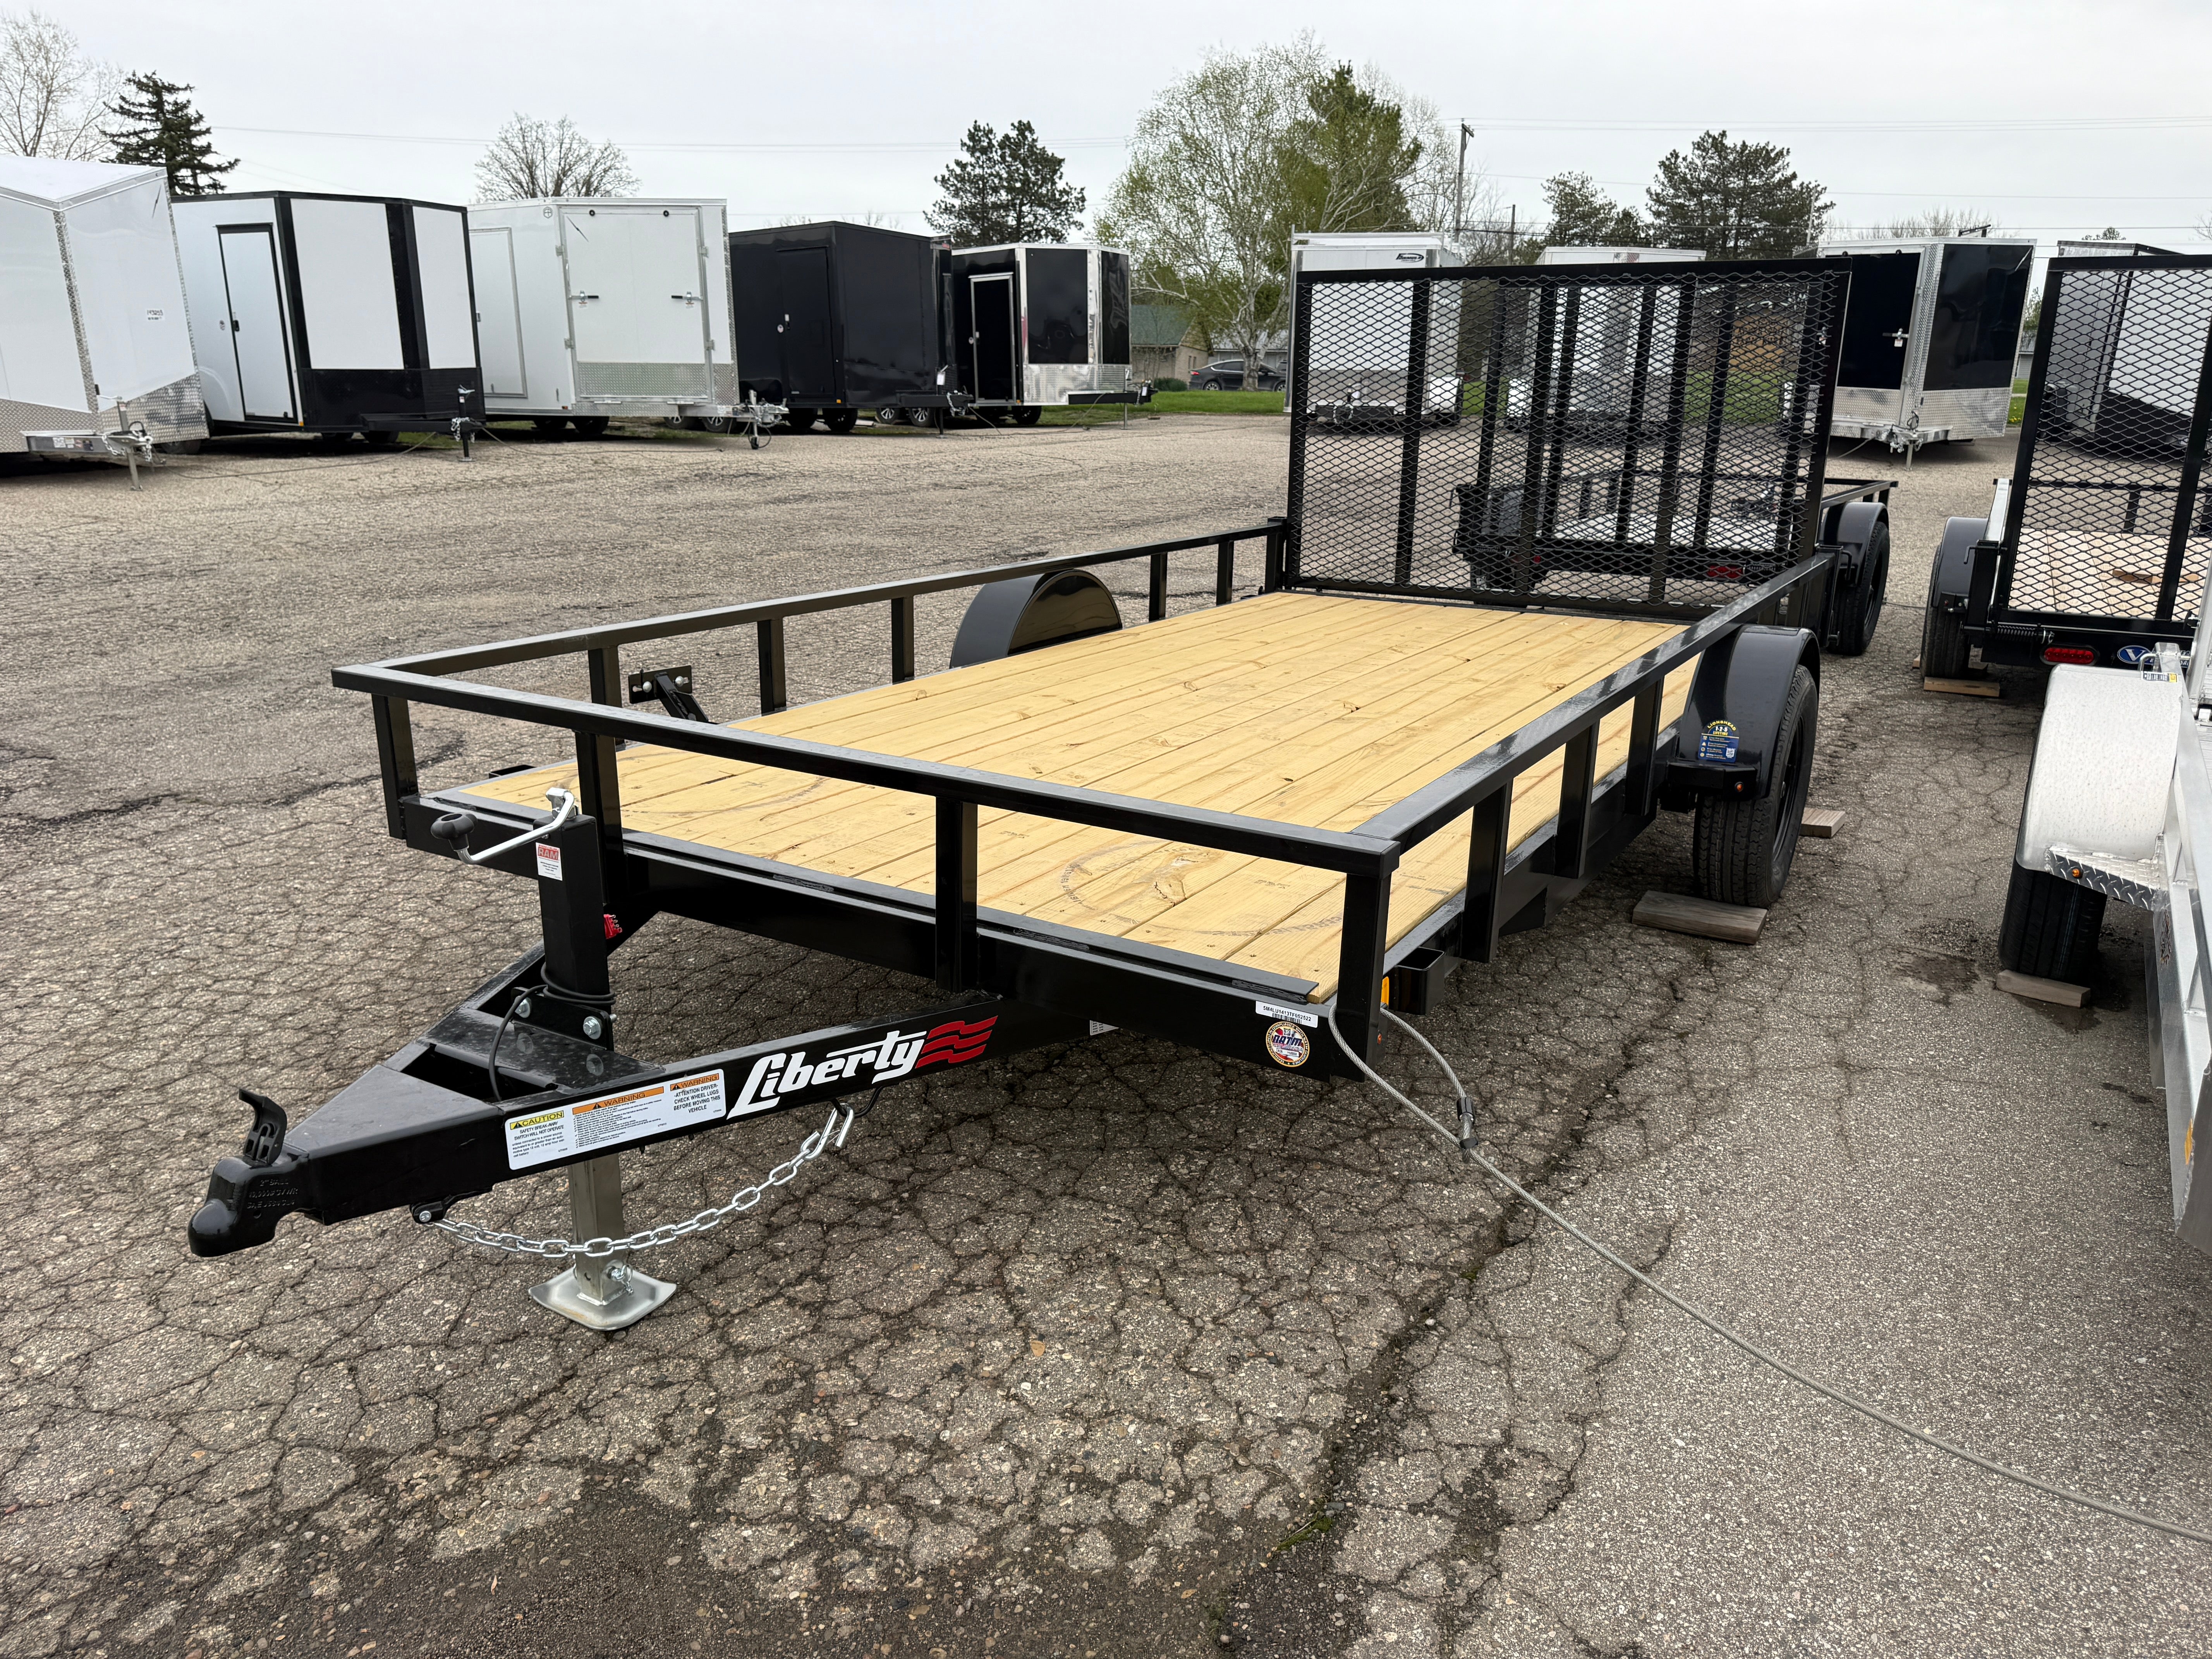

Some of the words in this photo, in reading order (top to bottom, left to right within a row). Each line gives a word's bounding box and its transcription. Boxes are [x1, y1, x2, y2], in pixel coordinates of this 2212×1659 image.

[1707, 720, 1736, 731] LIONSHEAD
[538, 848, 558, 860] RAM
[726, 1030, 927, 1120] Liberty
[681, 1075, 717, 1088] WARNING
[604, 1092, 646, 1106] WARNING
[674, 1103, 691, 1111] BEFORE
[689, 1104, 707, 1113] VEHICLE
[522, 1112, 562, 1126] CAUTION
[534, 1121, 558, 1130] BREAK-AWAY
